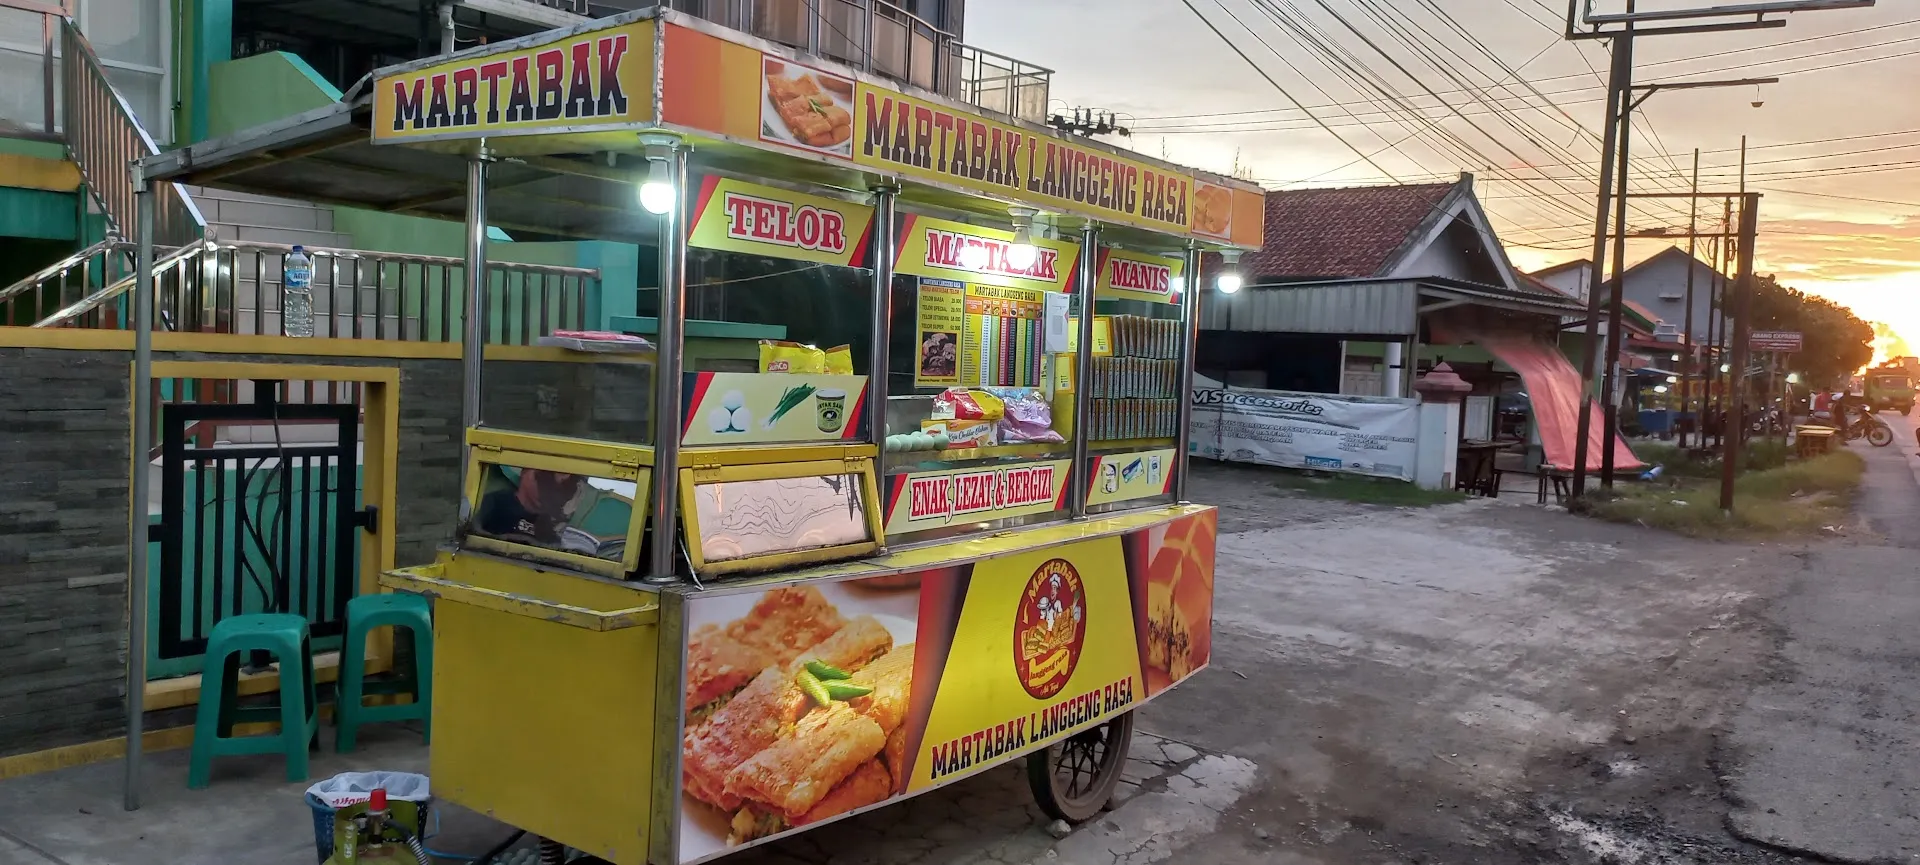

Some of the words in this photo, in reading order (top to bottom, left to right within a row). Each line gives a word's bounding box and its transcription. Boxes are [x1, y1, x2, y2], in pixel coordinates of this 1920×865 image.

[393, 34, 629, 132] MARTABAK
[863, 91, 1022, 190] MARTABAK
[1026, 136, 1137, 215] LANGGENG
[1141, 177, 1187, 226] RASA
[725, 193, 846, 253] TELOR
[926, 230, 1057, 280] MATAAK
[1110, 258, 1171, 294] MANIS
[974, 285, 1000, 298] MARTABAK
[911, 478, 953, 522] ENAK,
[954, 473, 994, 511] LEZAT
[994, 470, 1005, 507] &
[1007, 468, 1054, 505] BERGIZI
[1028, 560, 1078, 603] Martabak
[930, 715, 1026, 780] MARTABAK
[1030, 689, 1101, 743] LANGGENG
[1104, 676, 1133, 714] RASA
[332, 796, 371, 805] Alfam
